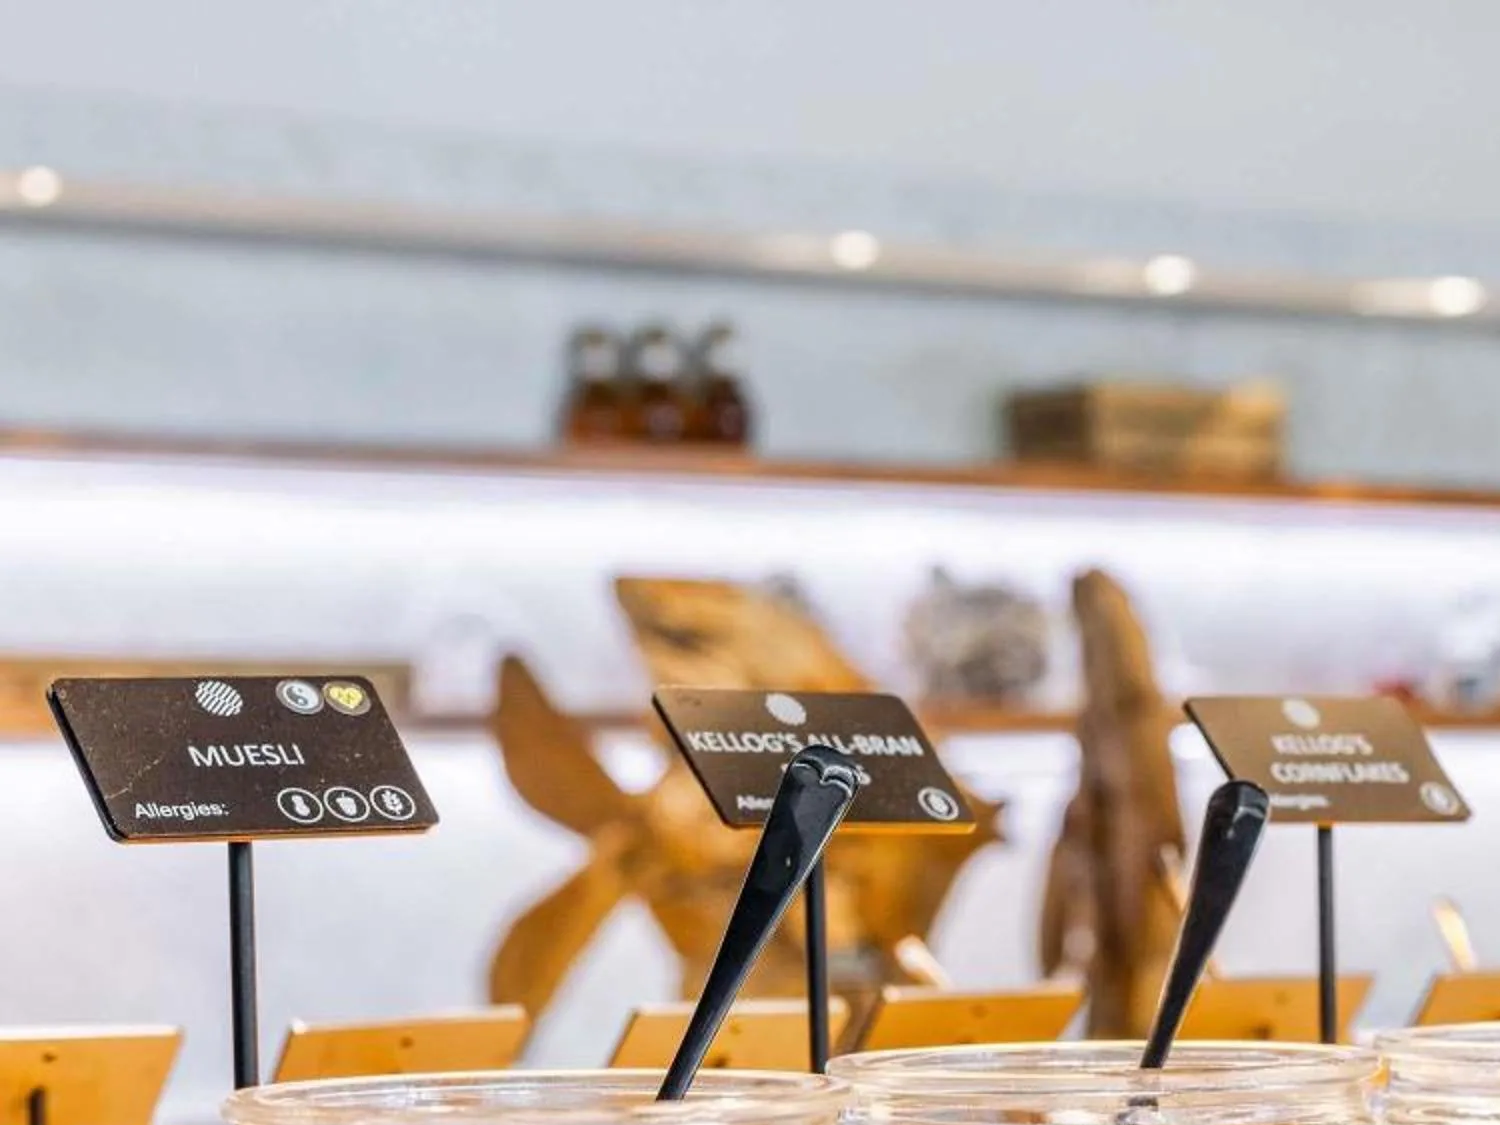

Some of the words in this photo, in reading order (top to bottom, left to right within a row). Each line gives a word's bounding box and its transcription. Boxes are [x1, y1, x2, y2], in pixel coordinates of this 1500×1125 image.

[687, 732, 801, 753] KELLOG'S
[187, 743, 306, 768] MUESLI
[134, 802, 230, 821] Allergies:
